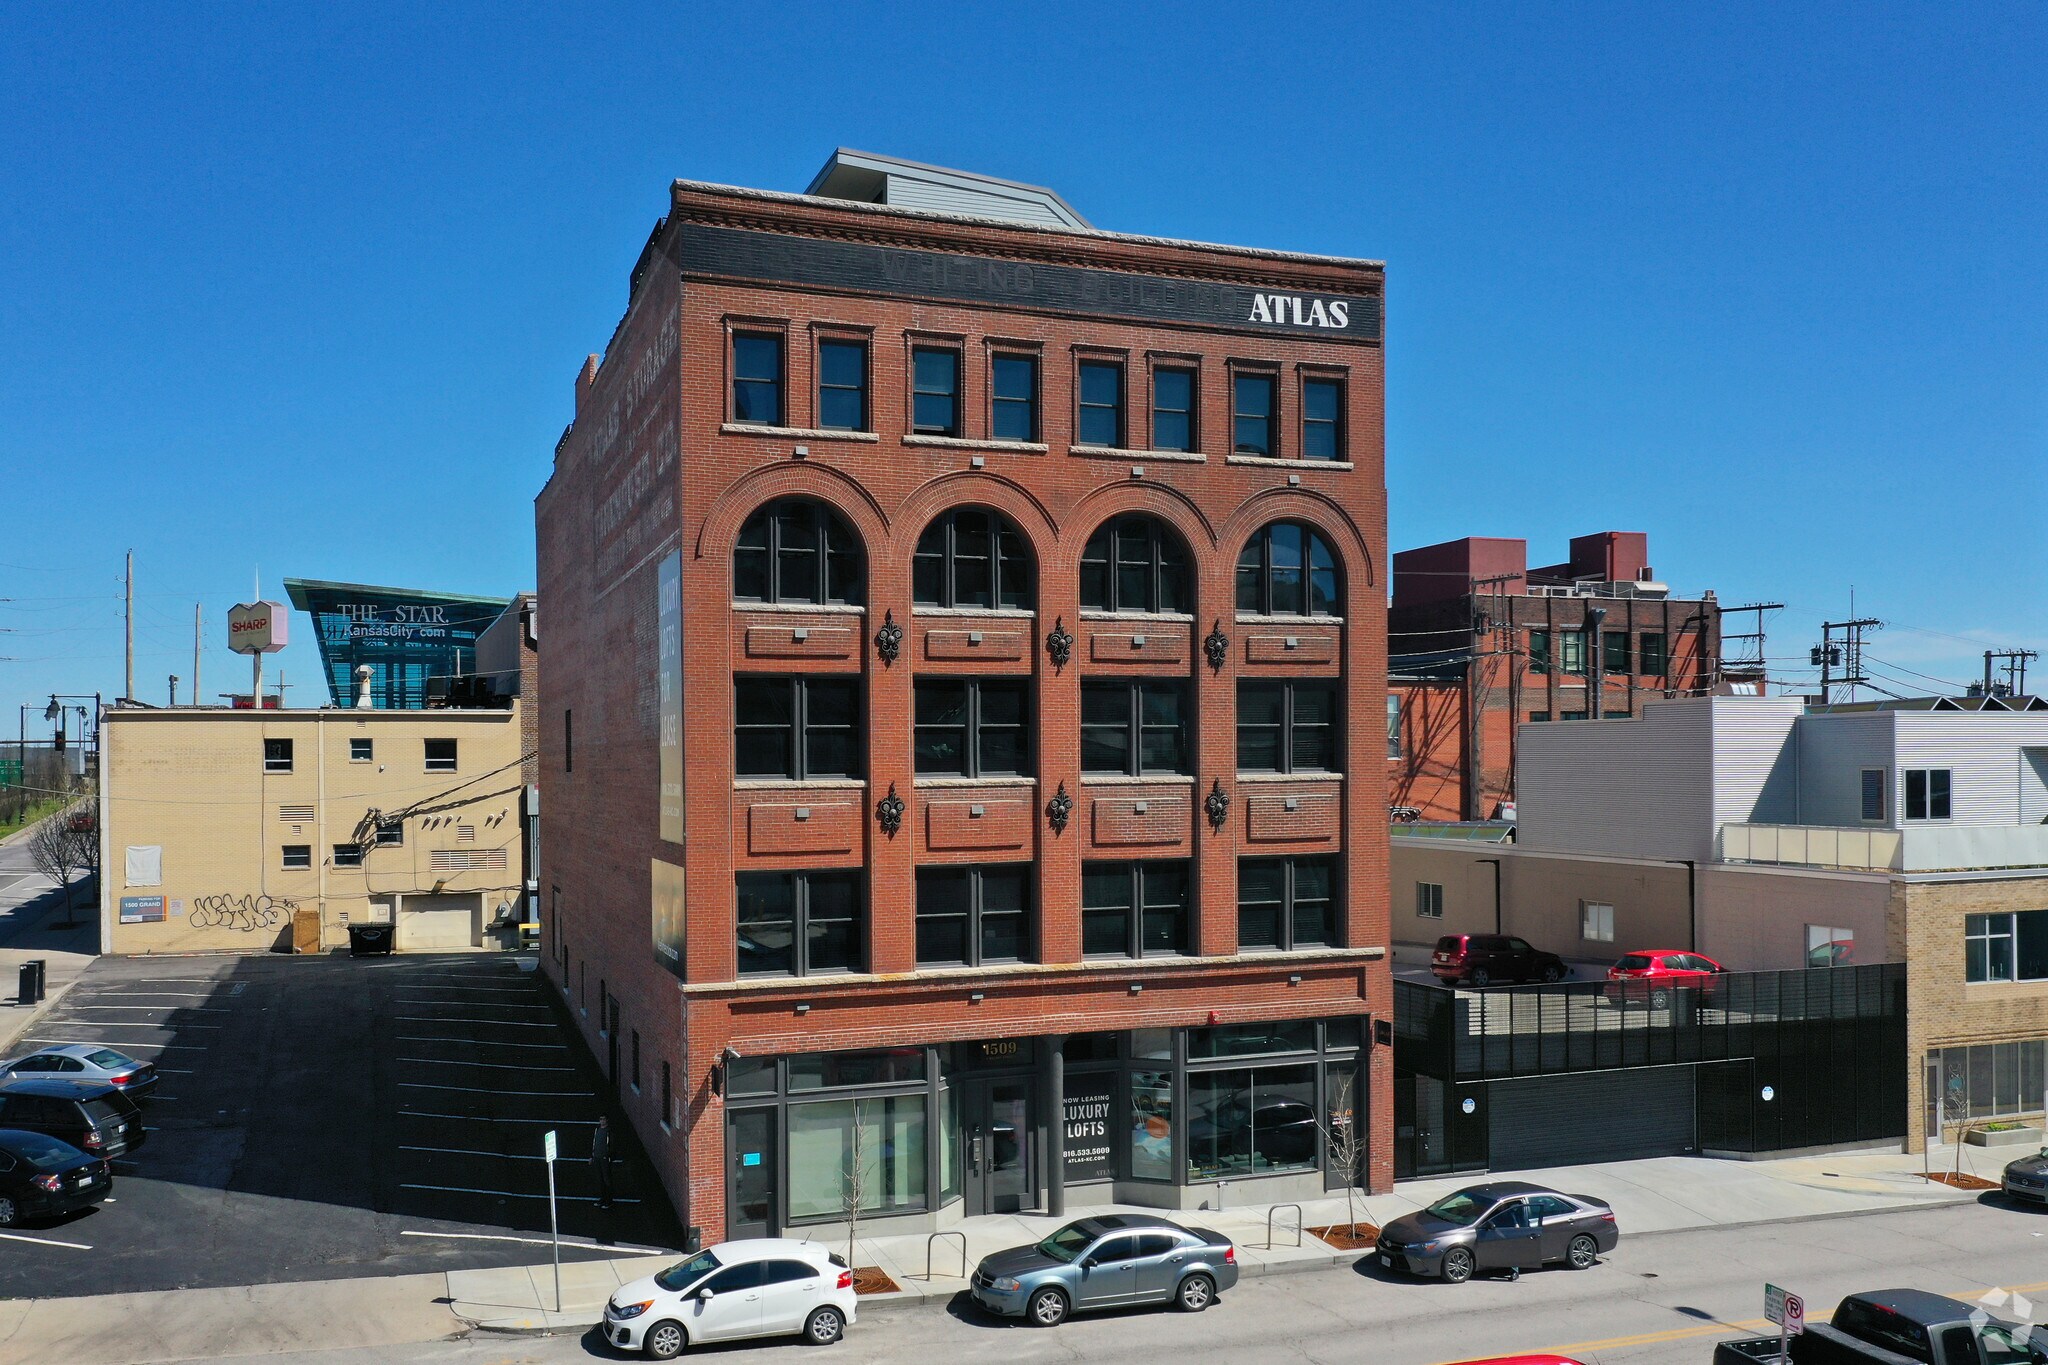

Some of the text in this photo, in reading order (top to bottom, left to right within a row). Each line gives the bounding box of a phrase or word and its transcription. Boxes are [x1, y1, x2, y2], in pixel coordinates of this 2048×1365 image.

[1248, 293, 1349, 329] ATLAS
[336, 604, 380, 621] THE
[231, 618, 268, 633] SHARP
[983, 1041, 1018, 1056] 1509
[1081, 1094, 1110, 1103] LEASING
[1062, 1102, 1110, 1121] LUXURY
[1067, 1121, 1105, 1138] LOFTS
